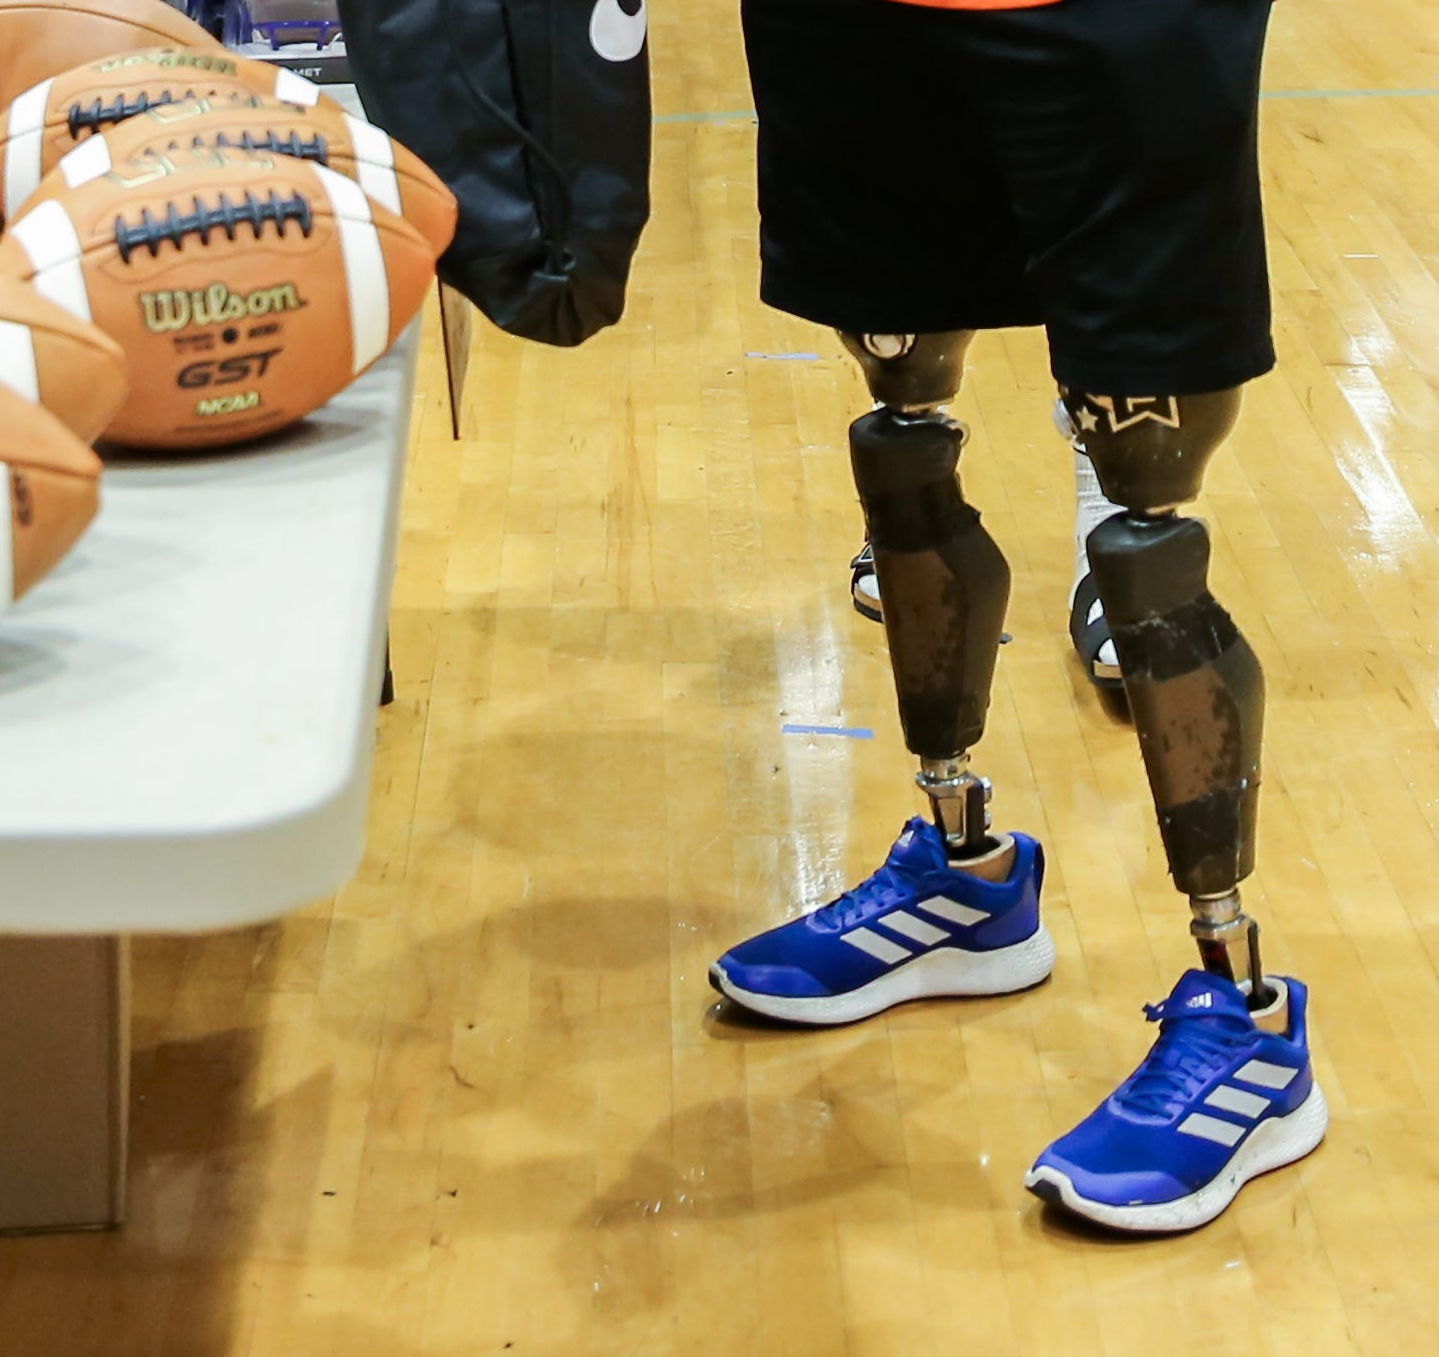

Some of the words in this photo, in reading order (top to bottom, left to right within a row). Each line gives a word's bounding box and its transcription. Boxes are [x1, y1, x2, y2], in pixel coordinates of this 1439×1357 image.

[139, 282, 301, 332] Wilson
[177, 347, 283, 389] GST
[195, 391, 260, 416] NCAA
